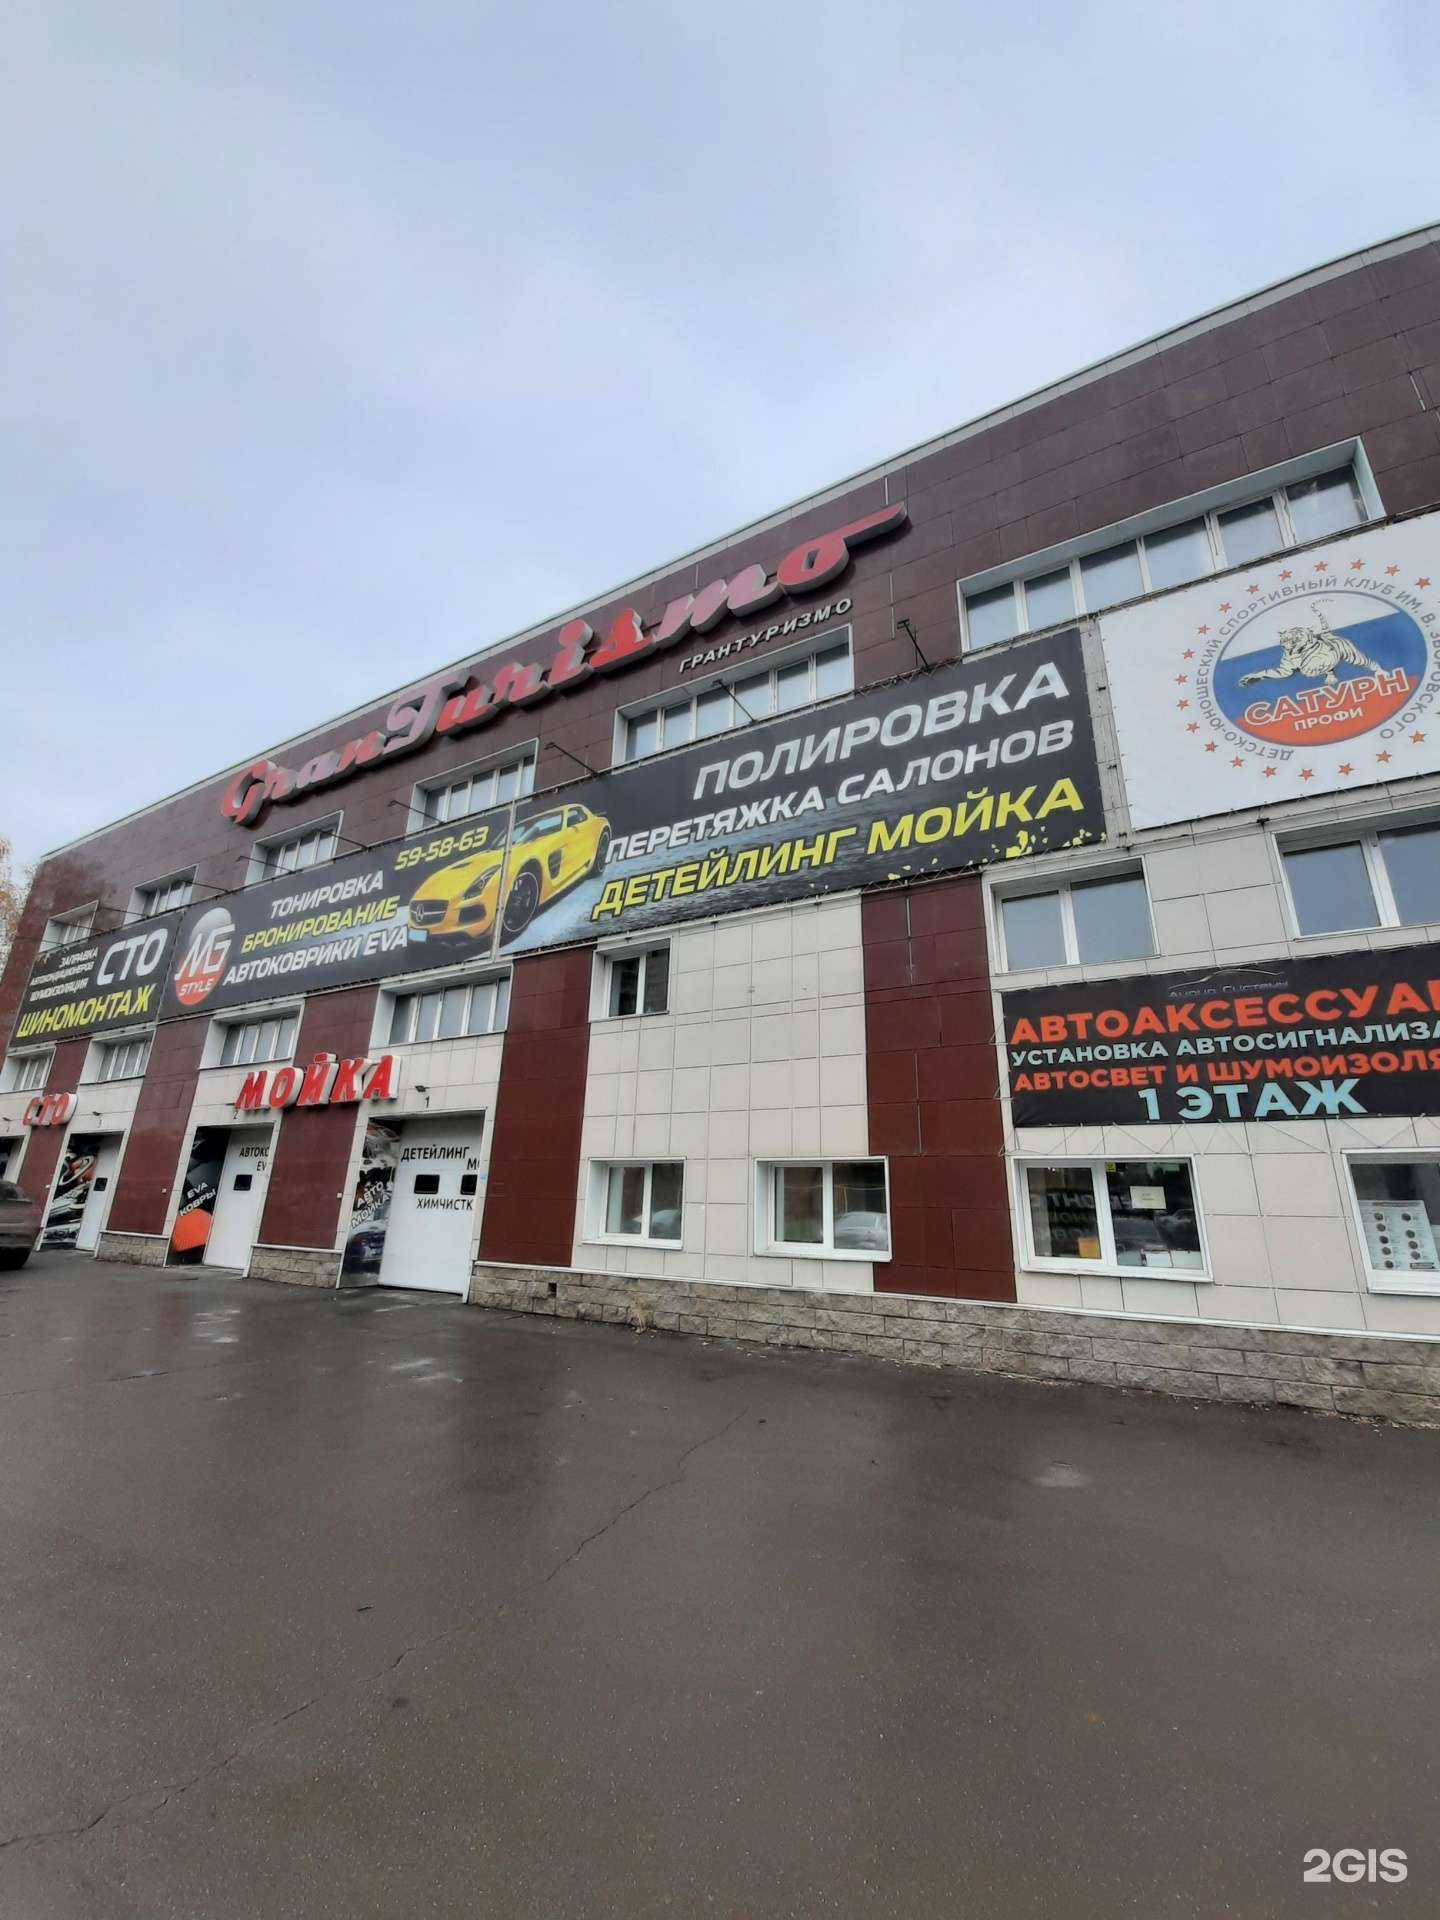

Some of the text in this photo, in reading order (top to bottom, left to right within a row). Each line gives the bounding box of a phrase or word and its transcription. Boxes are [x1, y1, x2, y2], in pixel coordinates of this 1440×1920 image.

[1219, 576, 1338, 636] СПОРТИВНЫЙ
[1343, 576, 1395, 596] КЛУБ
[1395, 590, 1423, 614] ИМ.
[1421, 612, 1437, 628] В.
[679, 598, 851, 674] ГРАНТУРИЗМО
[1243, 666, 1412, 726] САТУРН
[1294, 706, 1364, 731] ПРОФИ
[693, 661, 1070, 800] ПОЛИРОВКА
[604, 719, 1074, 864] ПЕРЕТЯЖКА САЛОНОВ
[394, 825, 490, 872] 59-58-63
[592, 777, 1085, 920] ДЕТЕЙЛИНГ МОЙКА
[270, 870, 384, 920] ТОНИРОВКА
[240, 895, 400, 955] БРОНИРОВАНИЕ
[96, 927, 168, 986] СТО
[222, 924, 409, 986] АВТОКОВРИКИ EVA
[16, 982, 157, 1038] ШИНОМОНТАЖ
[179, 978, 214, 997] STYLE
[1011, 1039, 1169, 1067] УСТАНОВКА
[235, 1051, 400, 1111] МОЙКА
[424, 1095, 430, 1108] 1
[1014, 1065, 1167, 1091] АВТОСВЕТ
[1176, 1064, 1197, 1083] И
[1138, 1077, 1368, 1120] 1 ЭТАЖ
[22, 1092, 77, 1126] СТО
[401, 1143, 470, 1163] ДЕТЕЙЛИНГ
[186, 1182, 209, 1199] EVA
[351, 1190, 392, 1229] МОЙКА
[357, 1181, 384, 1209] АВТО
